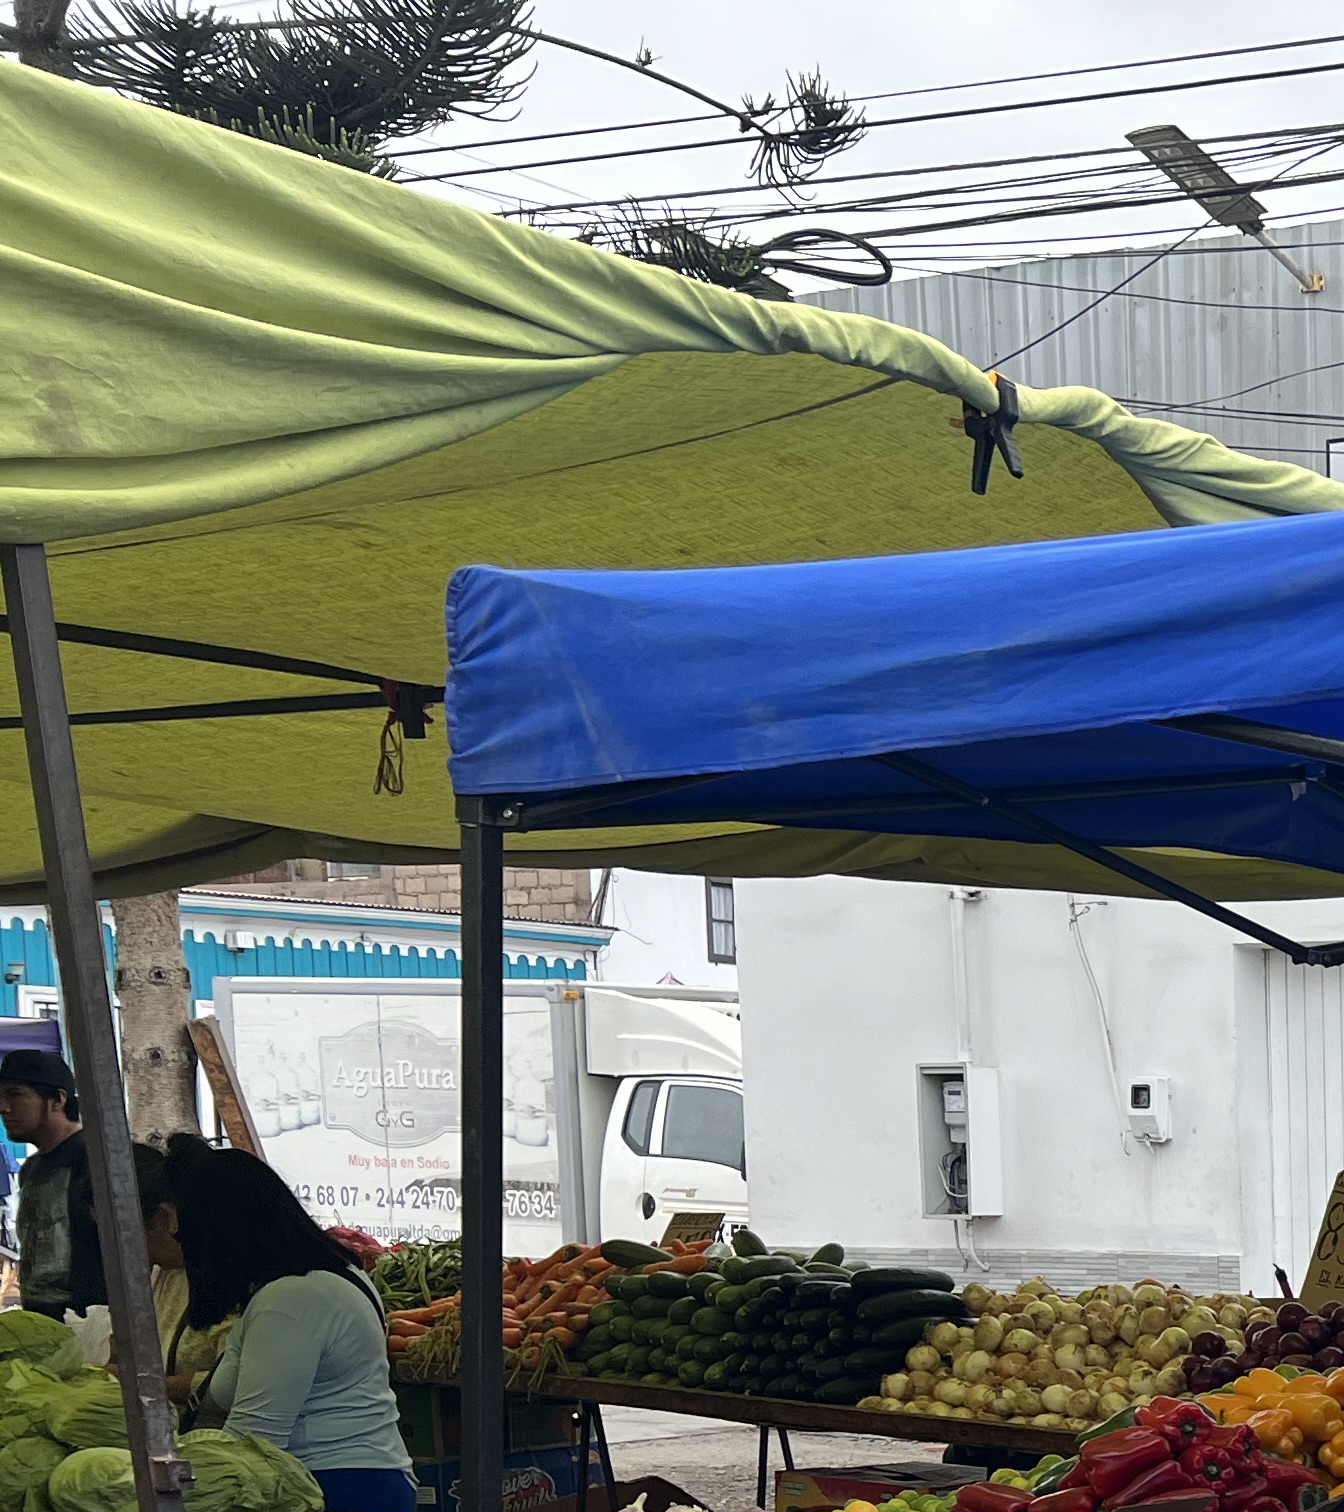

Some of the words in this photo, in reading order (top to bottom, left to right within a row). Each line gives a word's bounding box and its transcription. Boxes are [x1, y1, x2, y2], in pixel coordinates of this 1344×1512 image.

[348, 1153, 371, 1171] Muy
[374, 1155, 398, 1170] baa
[400, 1157, 415, 1169] en
[417, 1156, 451, 1171] Sodio
[316, 1184, 335, 1207] 68
[340, 1186, 359, 1207] 07
